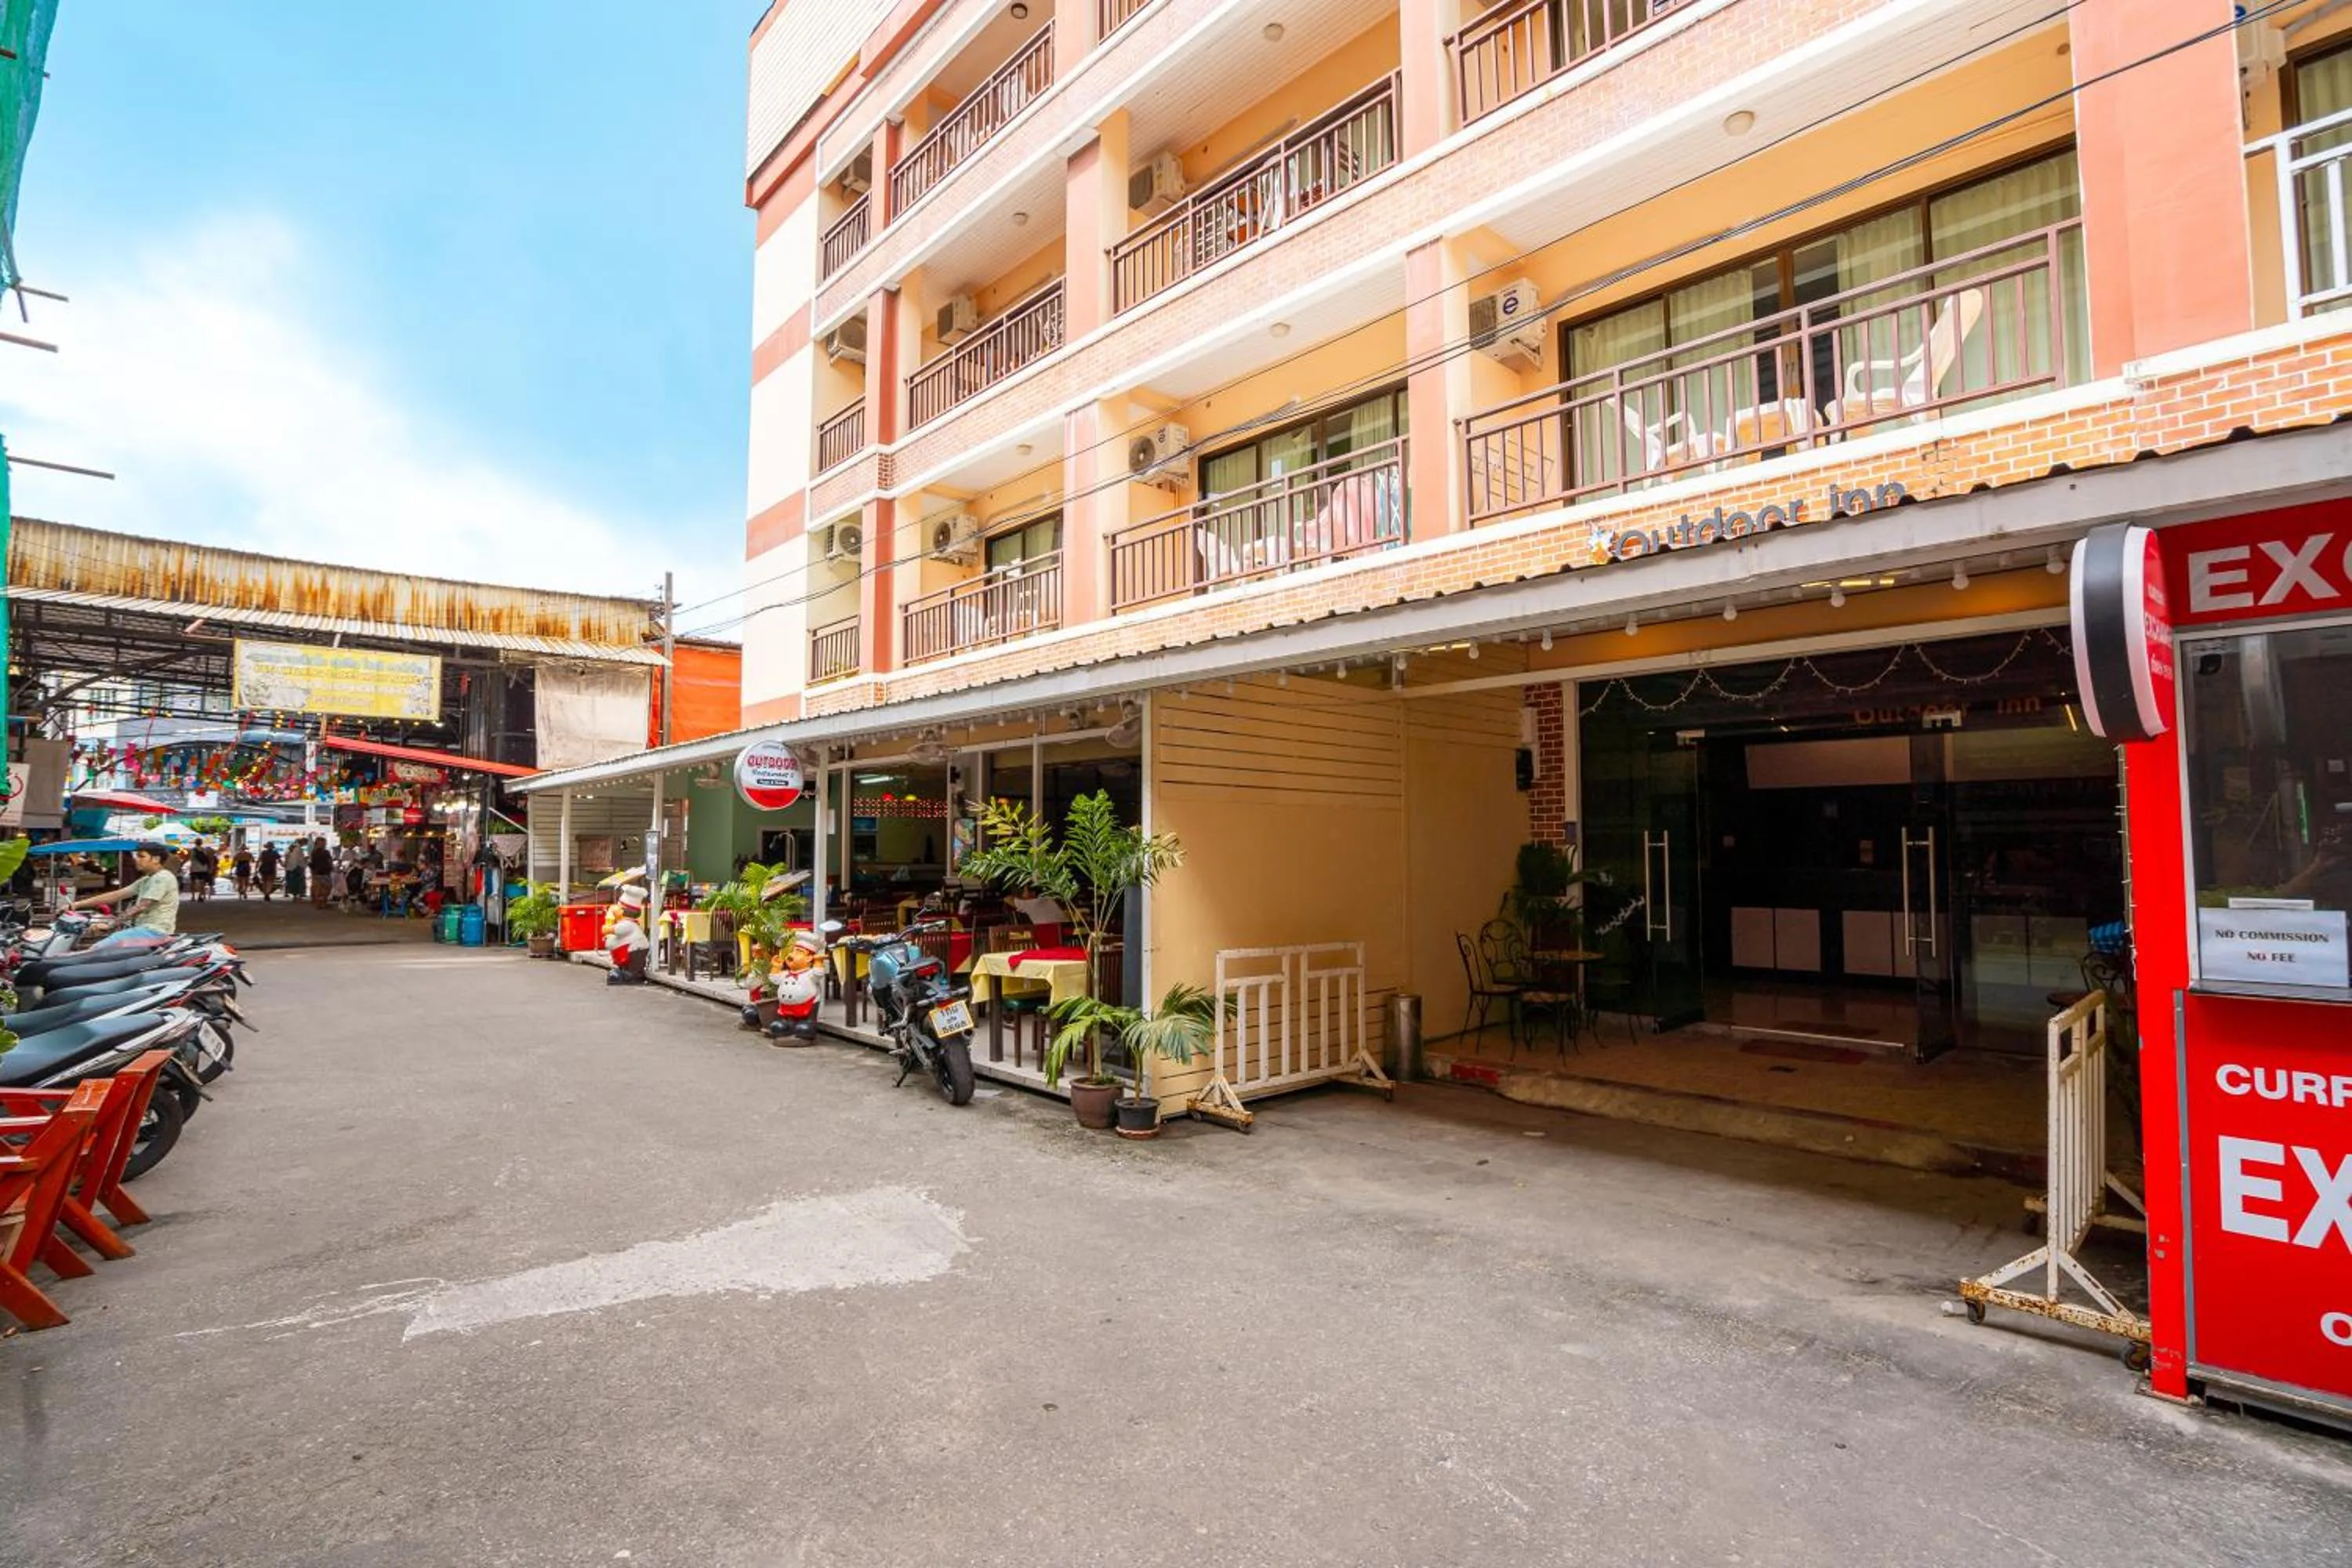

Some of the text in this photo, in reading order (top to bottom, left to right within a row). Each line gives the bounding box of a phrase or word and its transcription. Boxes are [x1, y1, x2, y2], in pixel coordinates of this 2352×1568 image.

[2187, 532, 2352, 615] EX
[747, 754, 798, 769] OUTDOOR
[2215, 929, 2330, 943] NO COMMISSION
[2246, 950, 2296, 964] NO FEE
